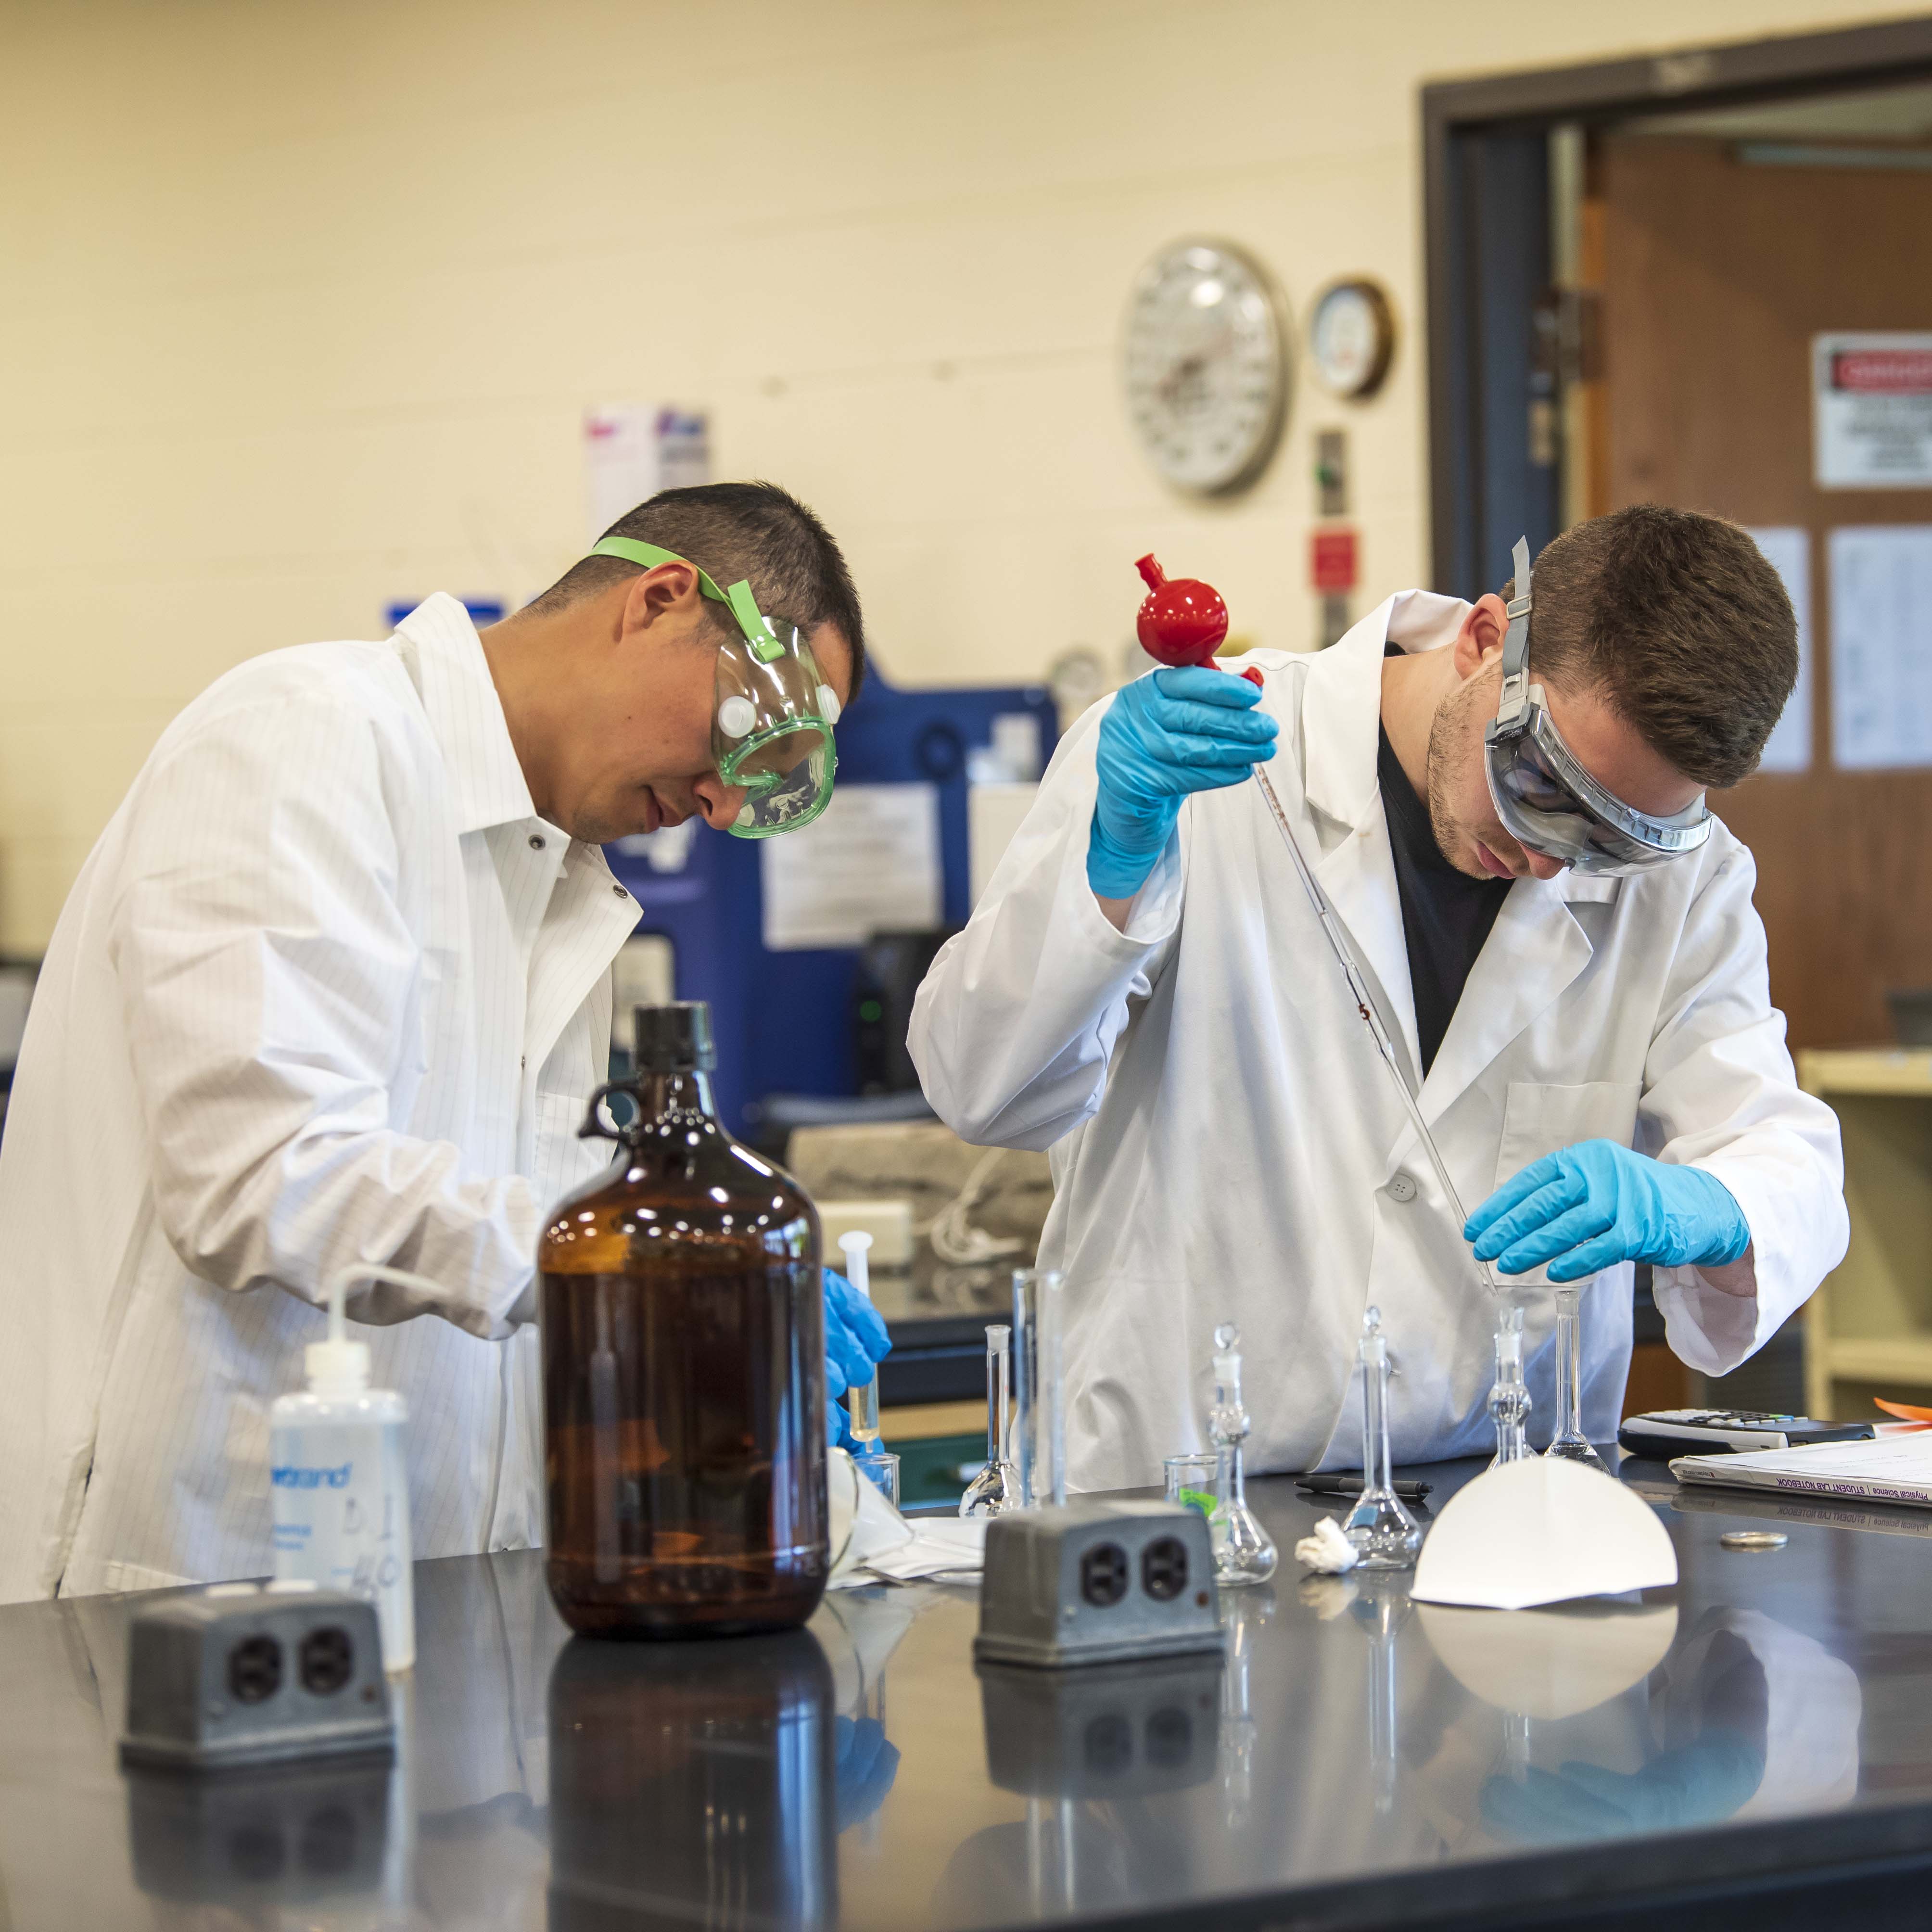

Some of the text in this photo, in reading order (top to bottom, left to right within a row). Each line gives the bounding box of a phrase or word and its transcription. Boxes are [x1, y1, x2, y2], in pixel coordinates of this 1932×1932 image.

[1359, 1004, 1370, 1020] 5
[1776, 1478, 1929, 1500] Physical Science STUDENT LAB NOTEBOOK
